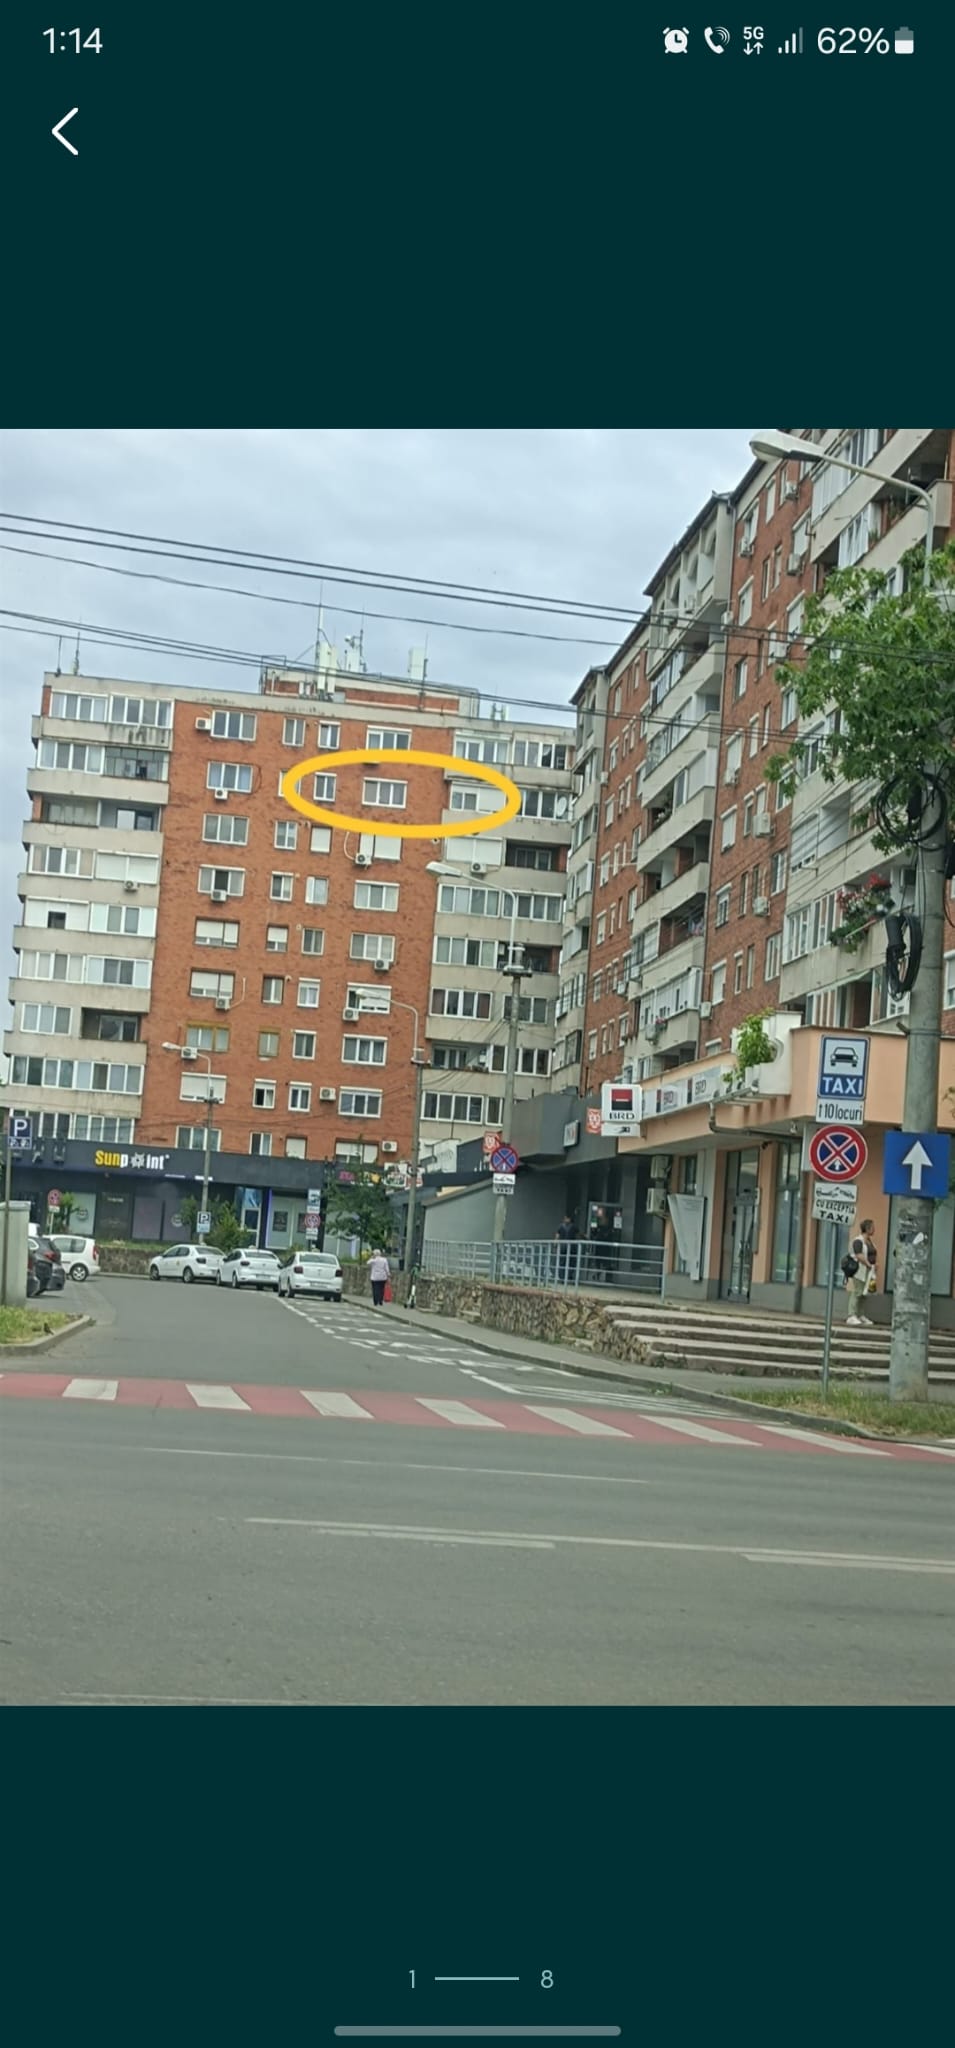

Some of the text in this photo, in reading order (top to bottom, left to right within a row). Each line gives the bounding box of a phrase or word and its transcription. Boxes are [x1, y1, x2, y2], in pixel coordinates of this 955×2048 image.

[822, 1077, 863, 1095] TAXI
[609, 1112, 635, 1120] BRD
[824, 1103, 862, 1121] 10 locuri
[14, 1119, 28, 1137] P
[816, 1199, 825, 1208] CU
[819, 1210, 849, 1223] TAXI
